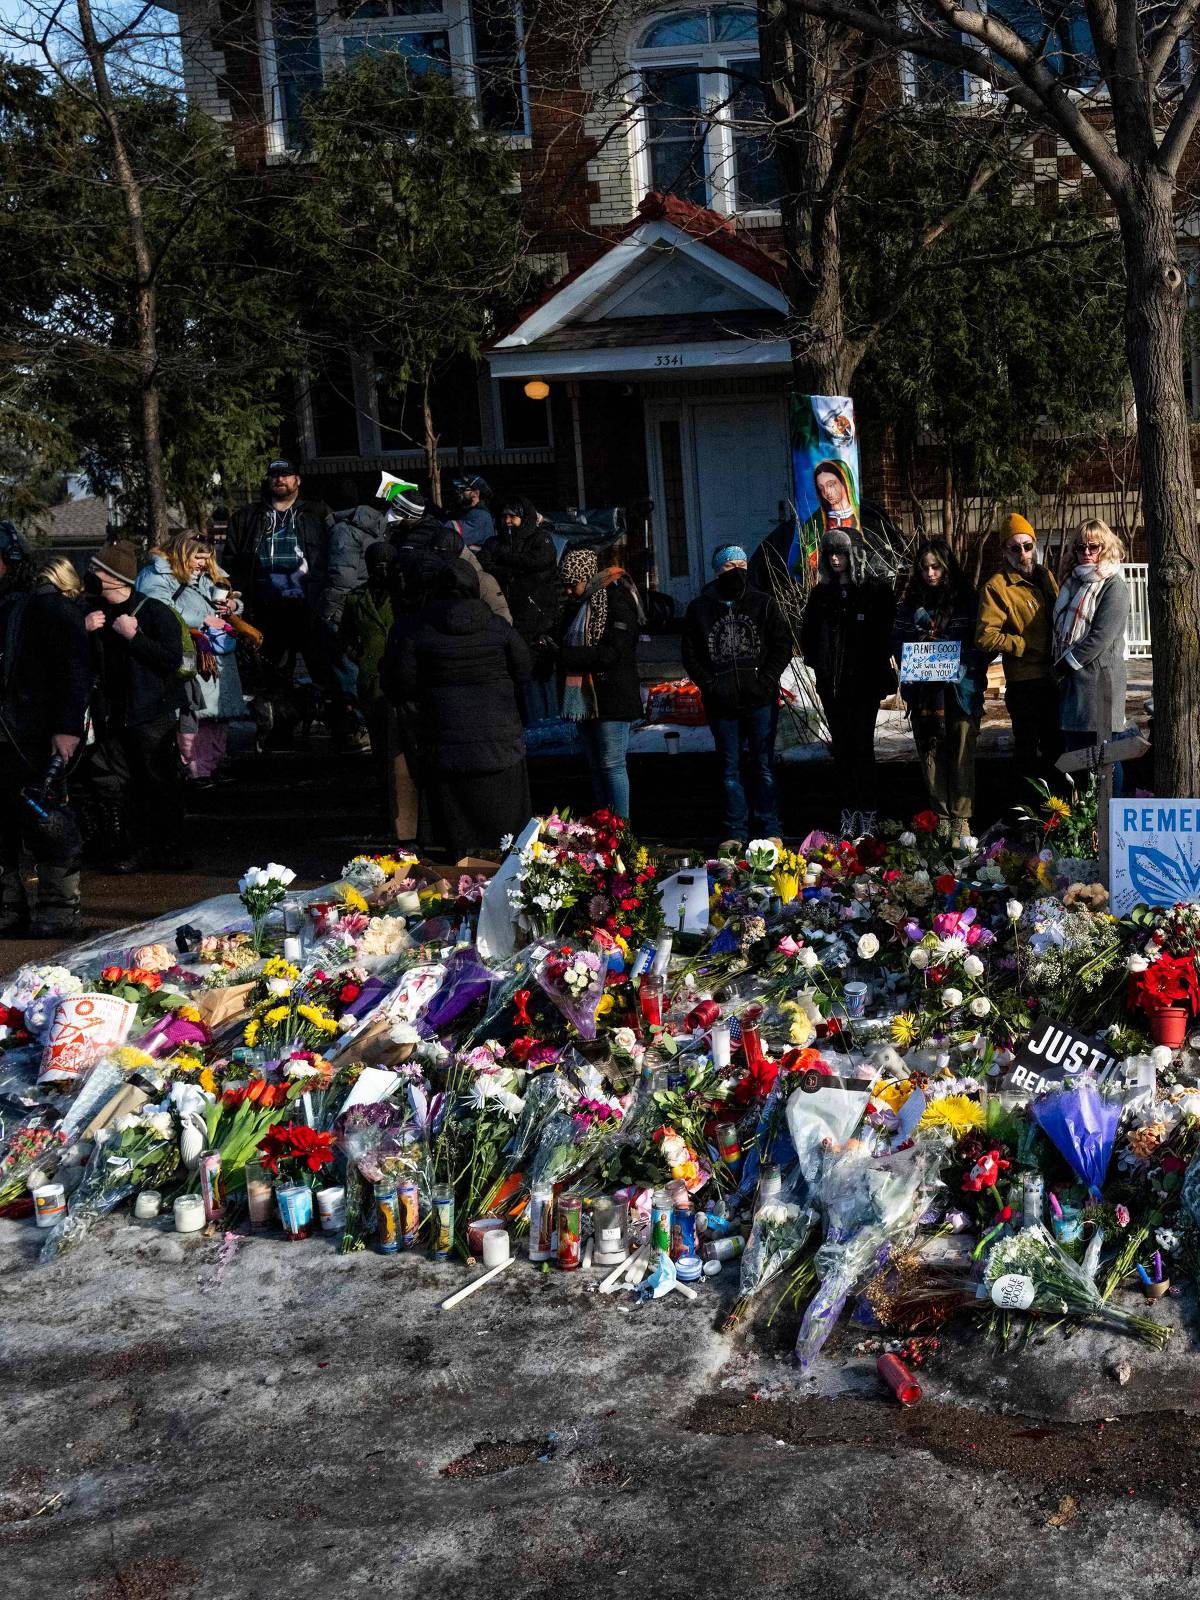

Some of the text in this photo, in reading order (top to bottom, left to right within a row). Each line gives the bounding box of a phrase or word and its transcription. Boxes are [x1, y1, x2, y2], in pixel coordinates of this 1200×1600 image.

[654, 355, 683, 367] 3341
[913, 644, 957, 654] RENEE GOOD
[1027, 1025, 1122, 1085] JUSTI
[1011, 1065, 1051, 1094] REN
[1000, 1277, 1017, 1307] WHOLE
[1009, 1280, 1024, 1307] FOODS
